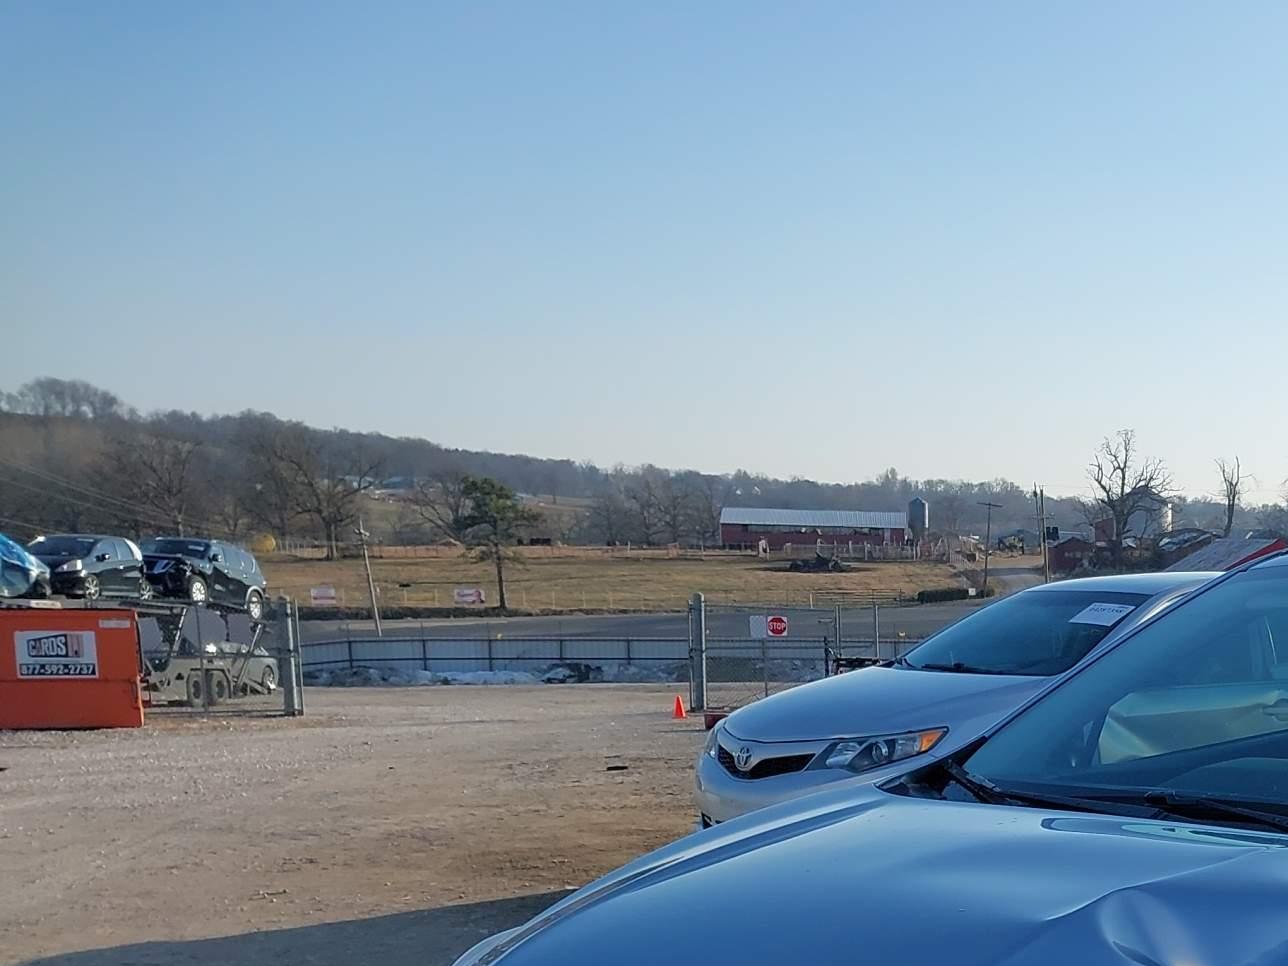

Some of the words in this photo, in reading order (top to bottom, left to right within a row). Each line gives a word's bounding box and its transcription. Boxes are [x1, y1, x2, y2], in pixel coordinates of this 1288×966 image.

[768, 621, 786, 631] STOP
[28, 635, 67, 656] CARDS
[21, 664, 94, 675] 877-592-2737
